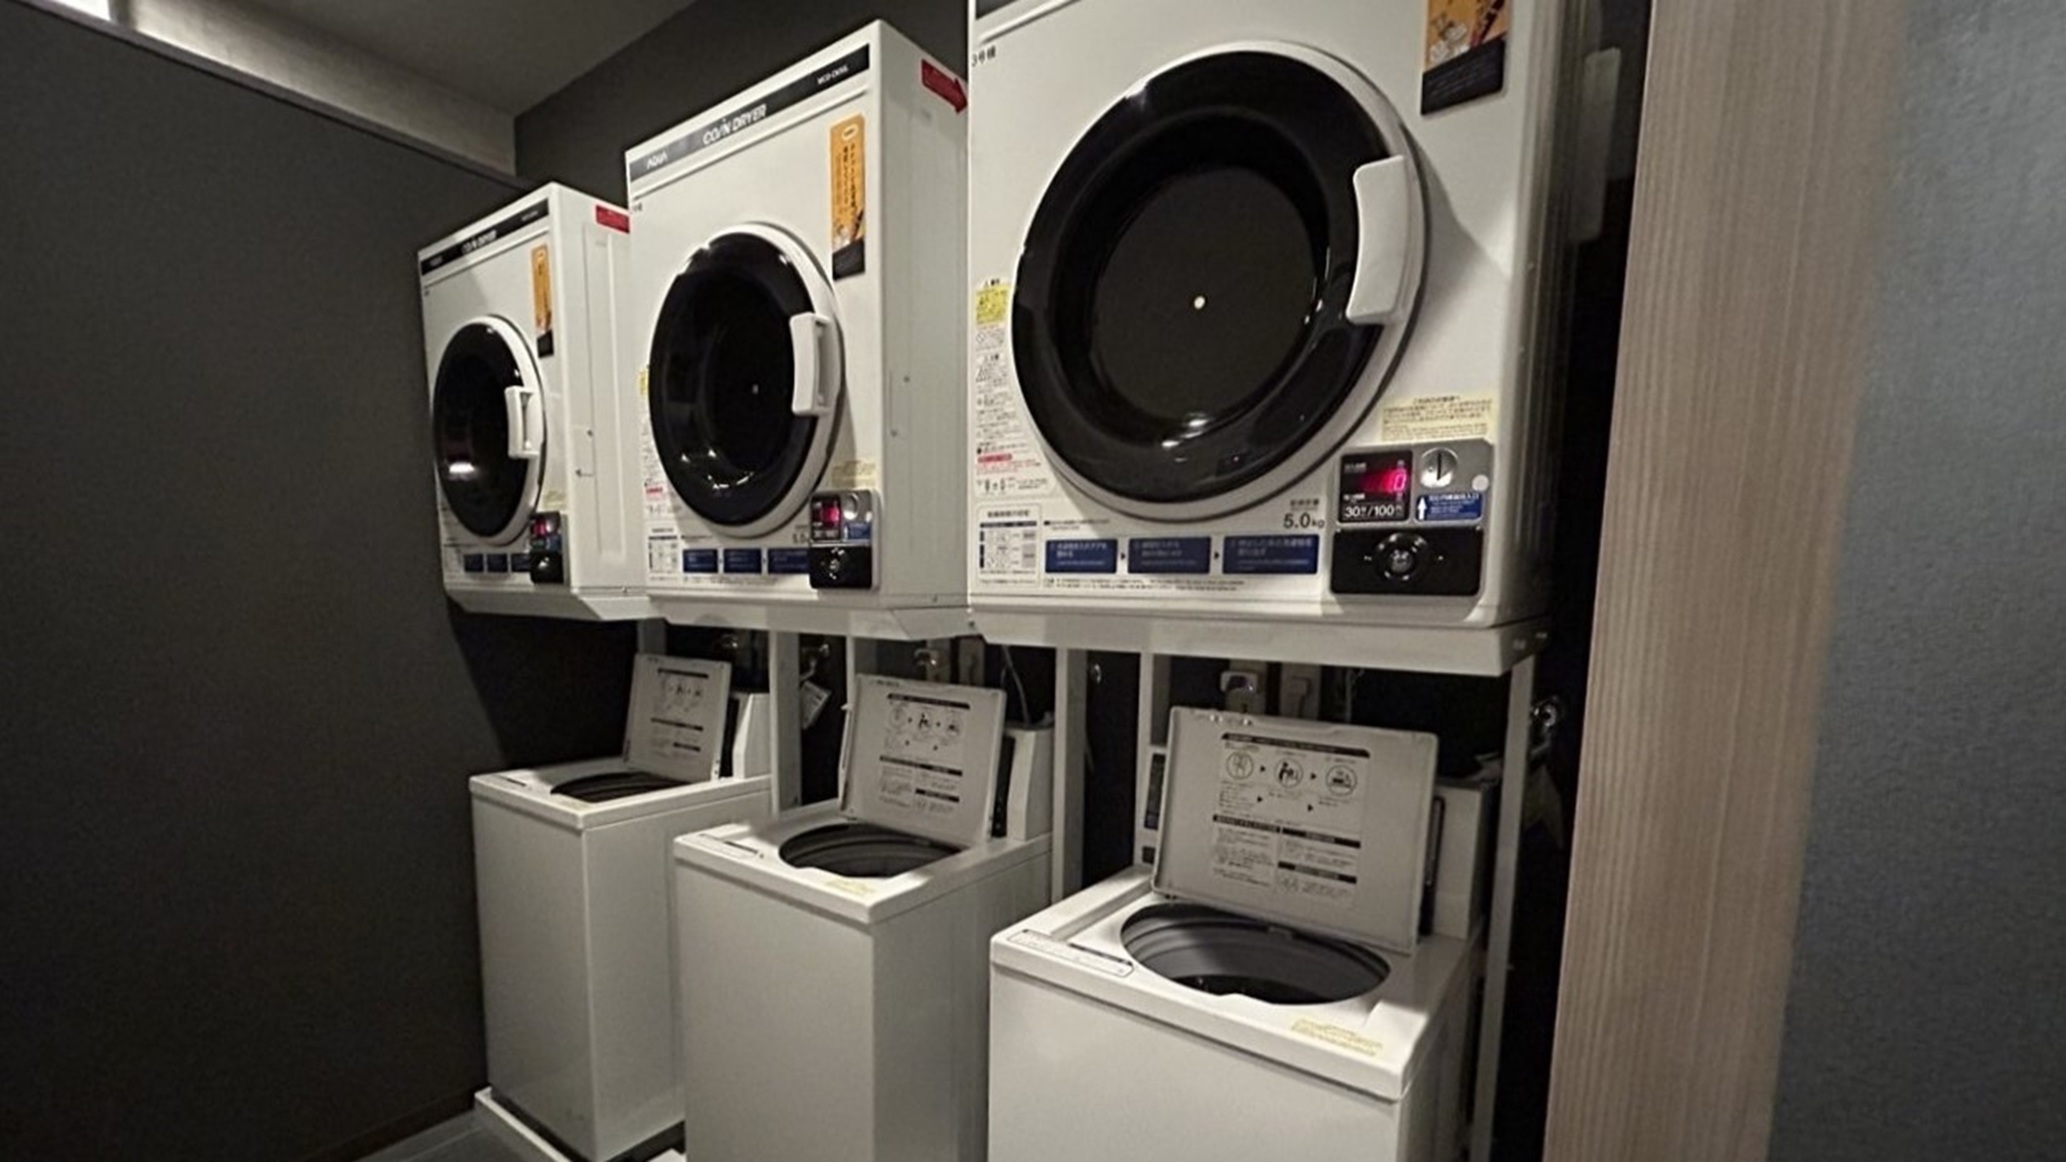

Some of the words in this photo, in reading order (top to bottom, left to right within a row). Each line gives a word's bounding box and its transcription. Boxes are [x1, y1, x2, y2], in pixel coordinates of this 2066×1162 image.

[733, 103, 768, 132] DRYER
[1393, 468, 1408, 492] 0
[1283, 511, 1326, 529] 5.0kg
